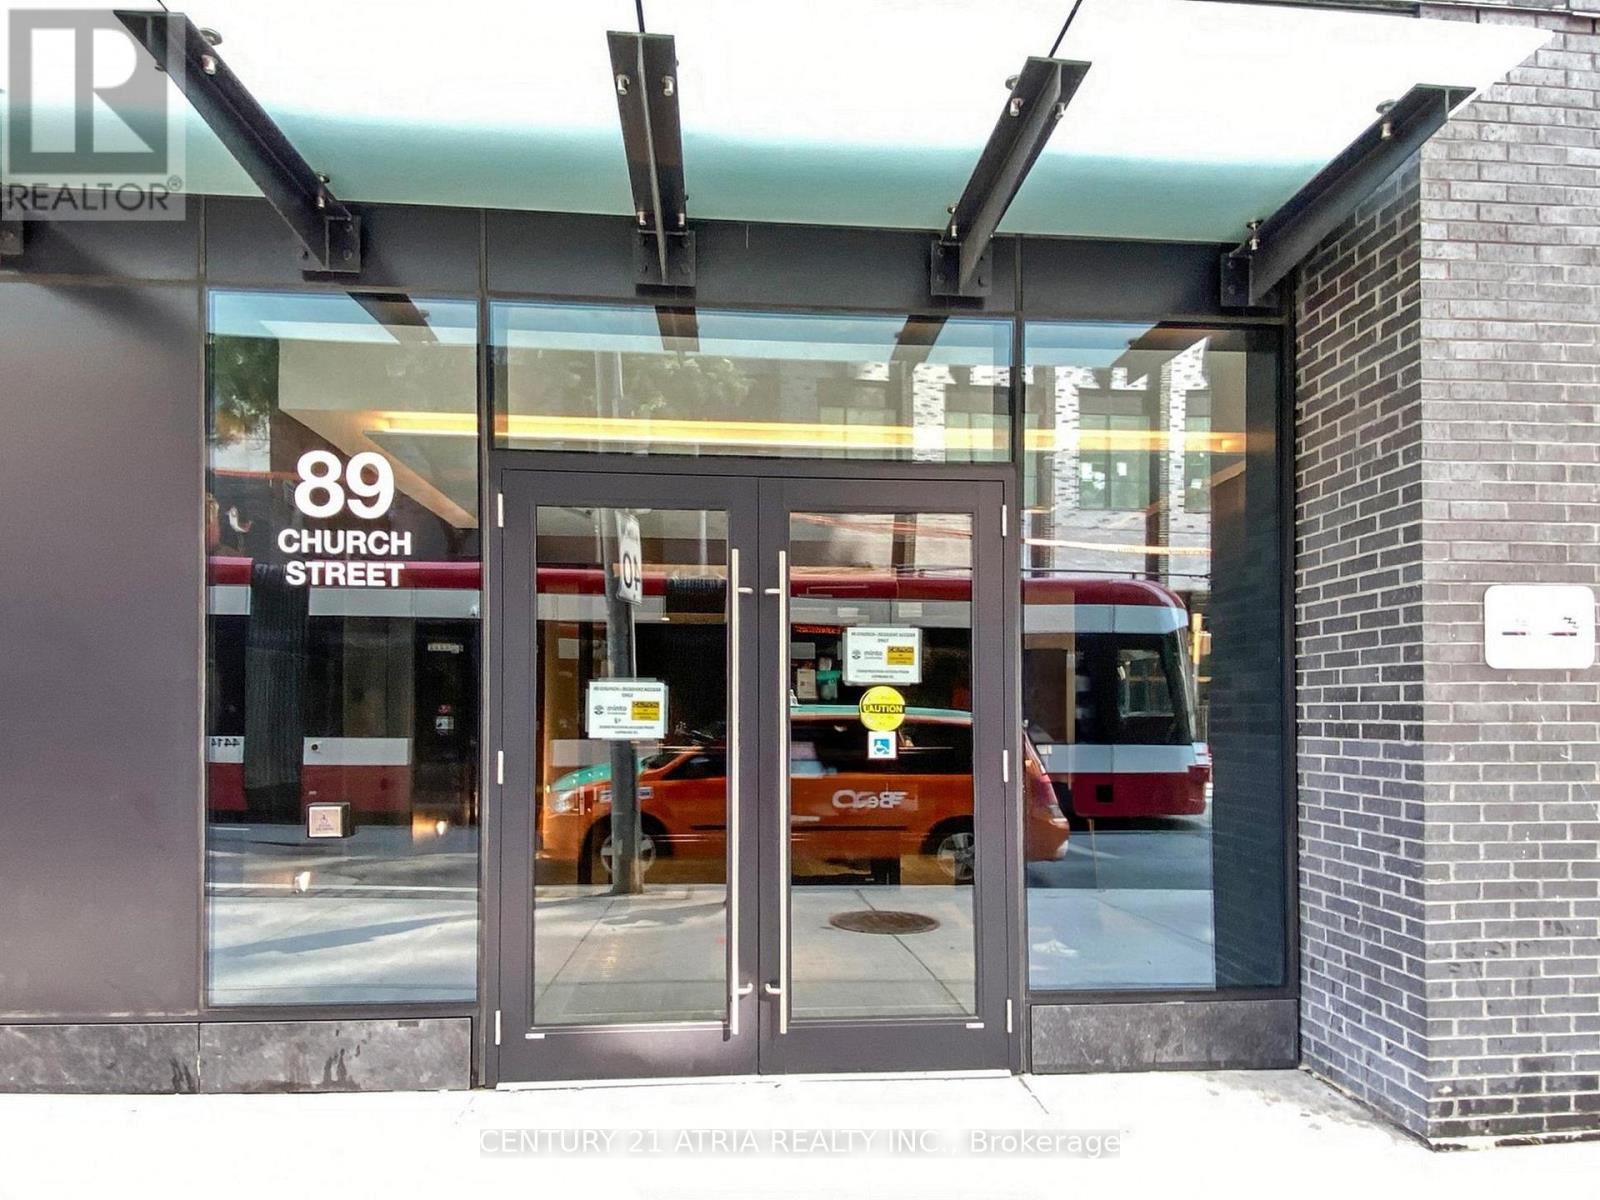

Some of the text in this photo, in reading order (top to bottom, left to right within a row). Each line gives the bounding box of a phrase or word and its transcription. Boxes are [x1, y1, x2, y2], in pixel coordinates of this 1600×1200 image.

[294, 449, 395, 519] 89
[277, 528, 412, 556] CHURCH
[285, 560, 405, 587] STREET
[863, 704, 903, 713] CAUTION
